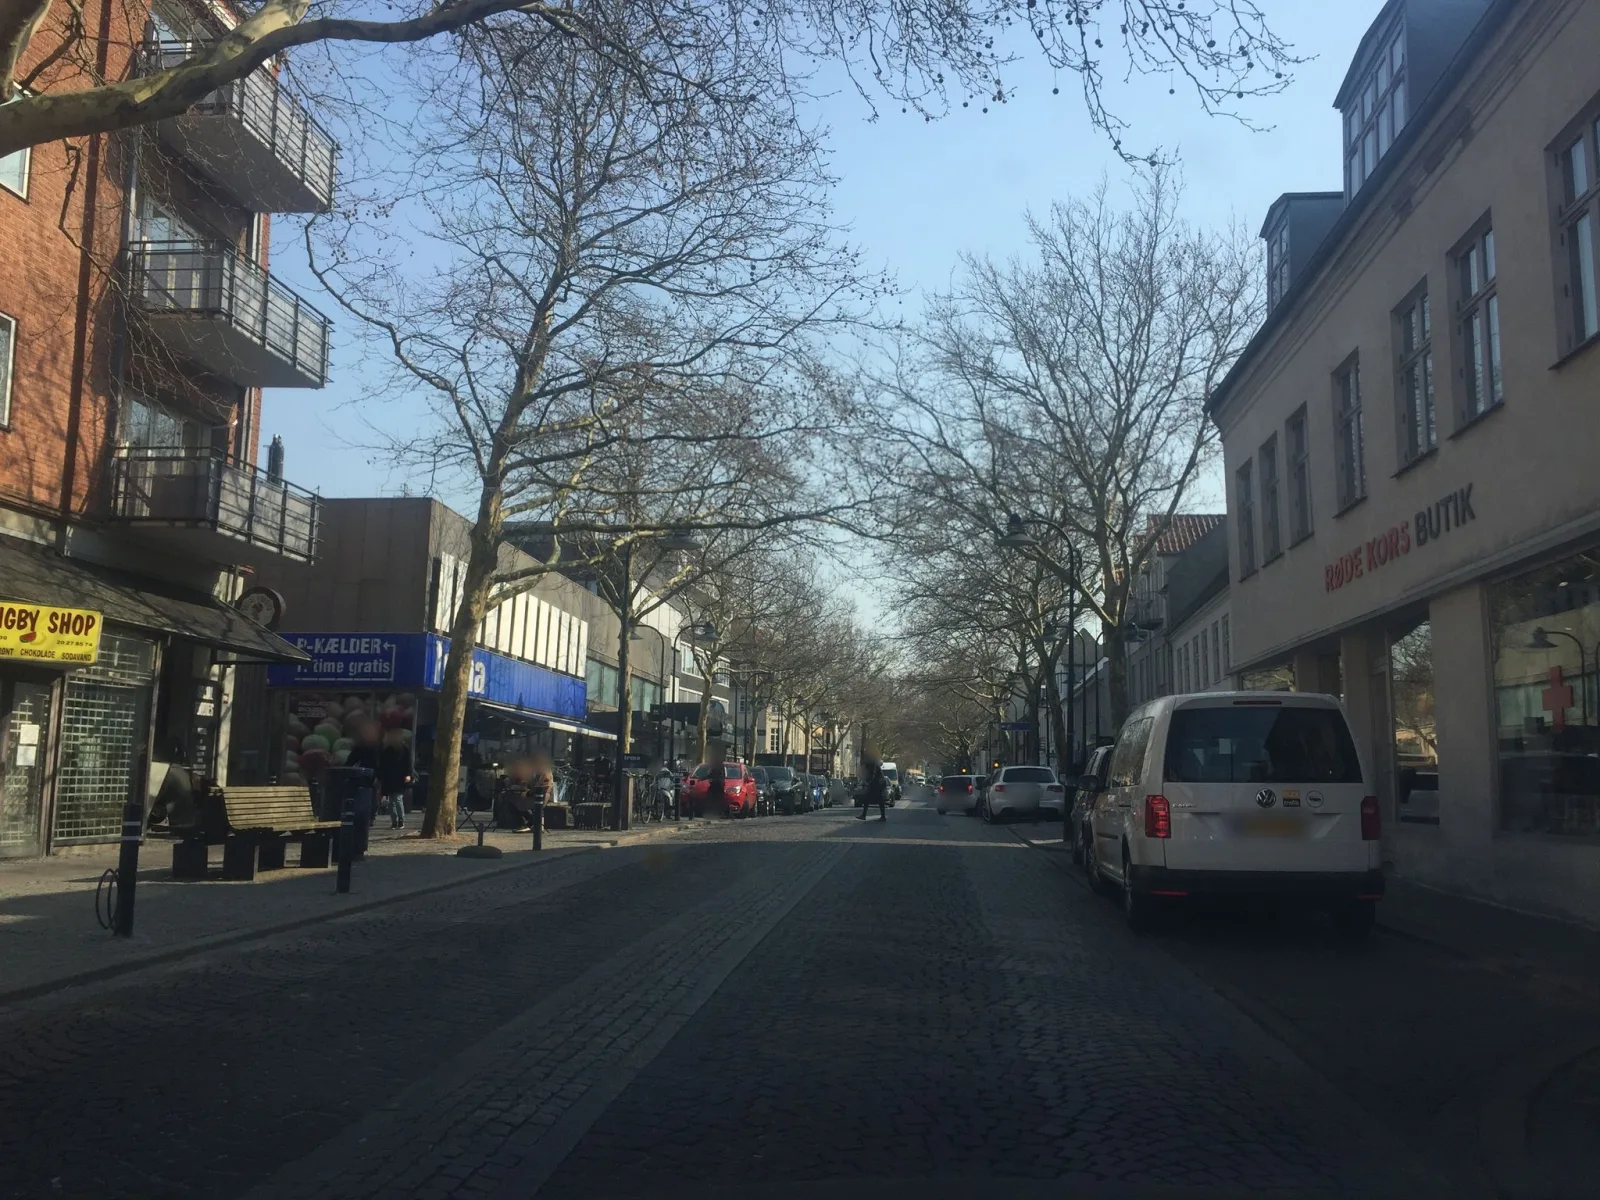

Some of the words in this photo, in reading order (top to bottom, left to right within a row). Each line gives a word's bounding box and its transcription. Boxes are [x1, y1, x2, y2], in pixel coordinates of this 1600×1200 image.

[1322, 545, 1364, 593] RØDE
[1366, 520, 1412, 572] KORS
[1414, 482, 1477, 546] BUTIK
[47, 611, 96, 636] SHOP
[20, 648, 56, 659] CHOKOLADE
[61, 652, 92, 662] SODAVAND
[312, 658, 344, 673] time
[348, 657, 391, 676] gratis
[433, 640, 486, 695] Ia
